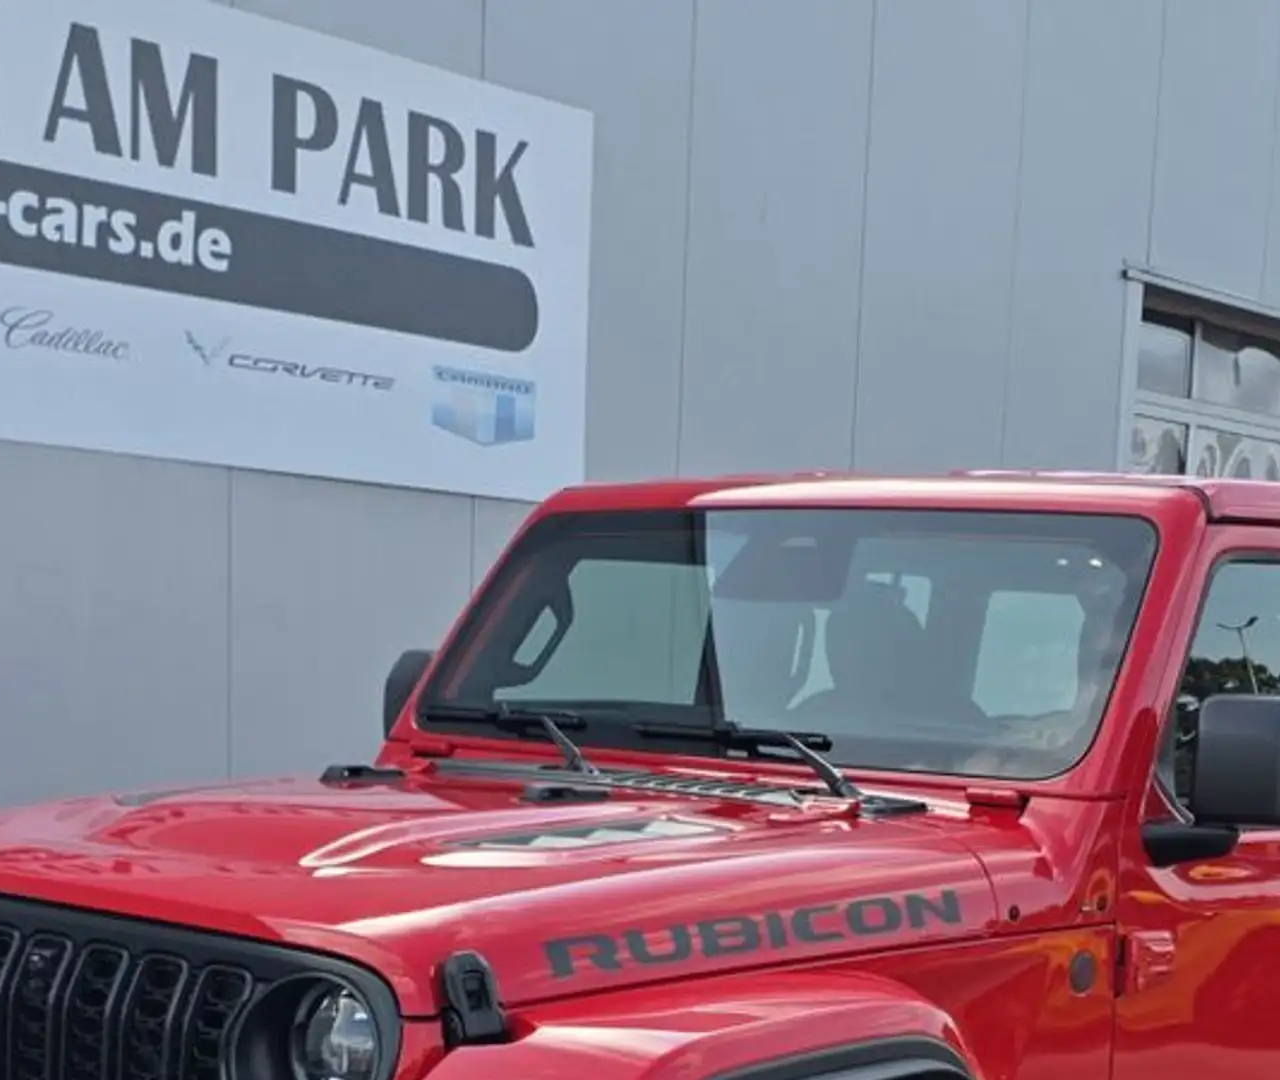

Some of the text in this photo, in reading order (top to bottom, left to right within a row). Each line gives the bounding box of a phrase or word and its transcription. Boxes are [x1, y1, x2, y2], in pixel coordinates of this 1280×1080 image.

[43, 21, 218, 178] AM
[270, 73, 535, 248] PARK
[228, 353, 396, 391] CORVETTE
[543, 888, 962, 979] RUBICON
